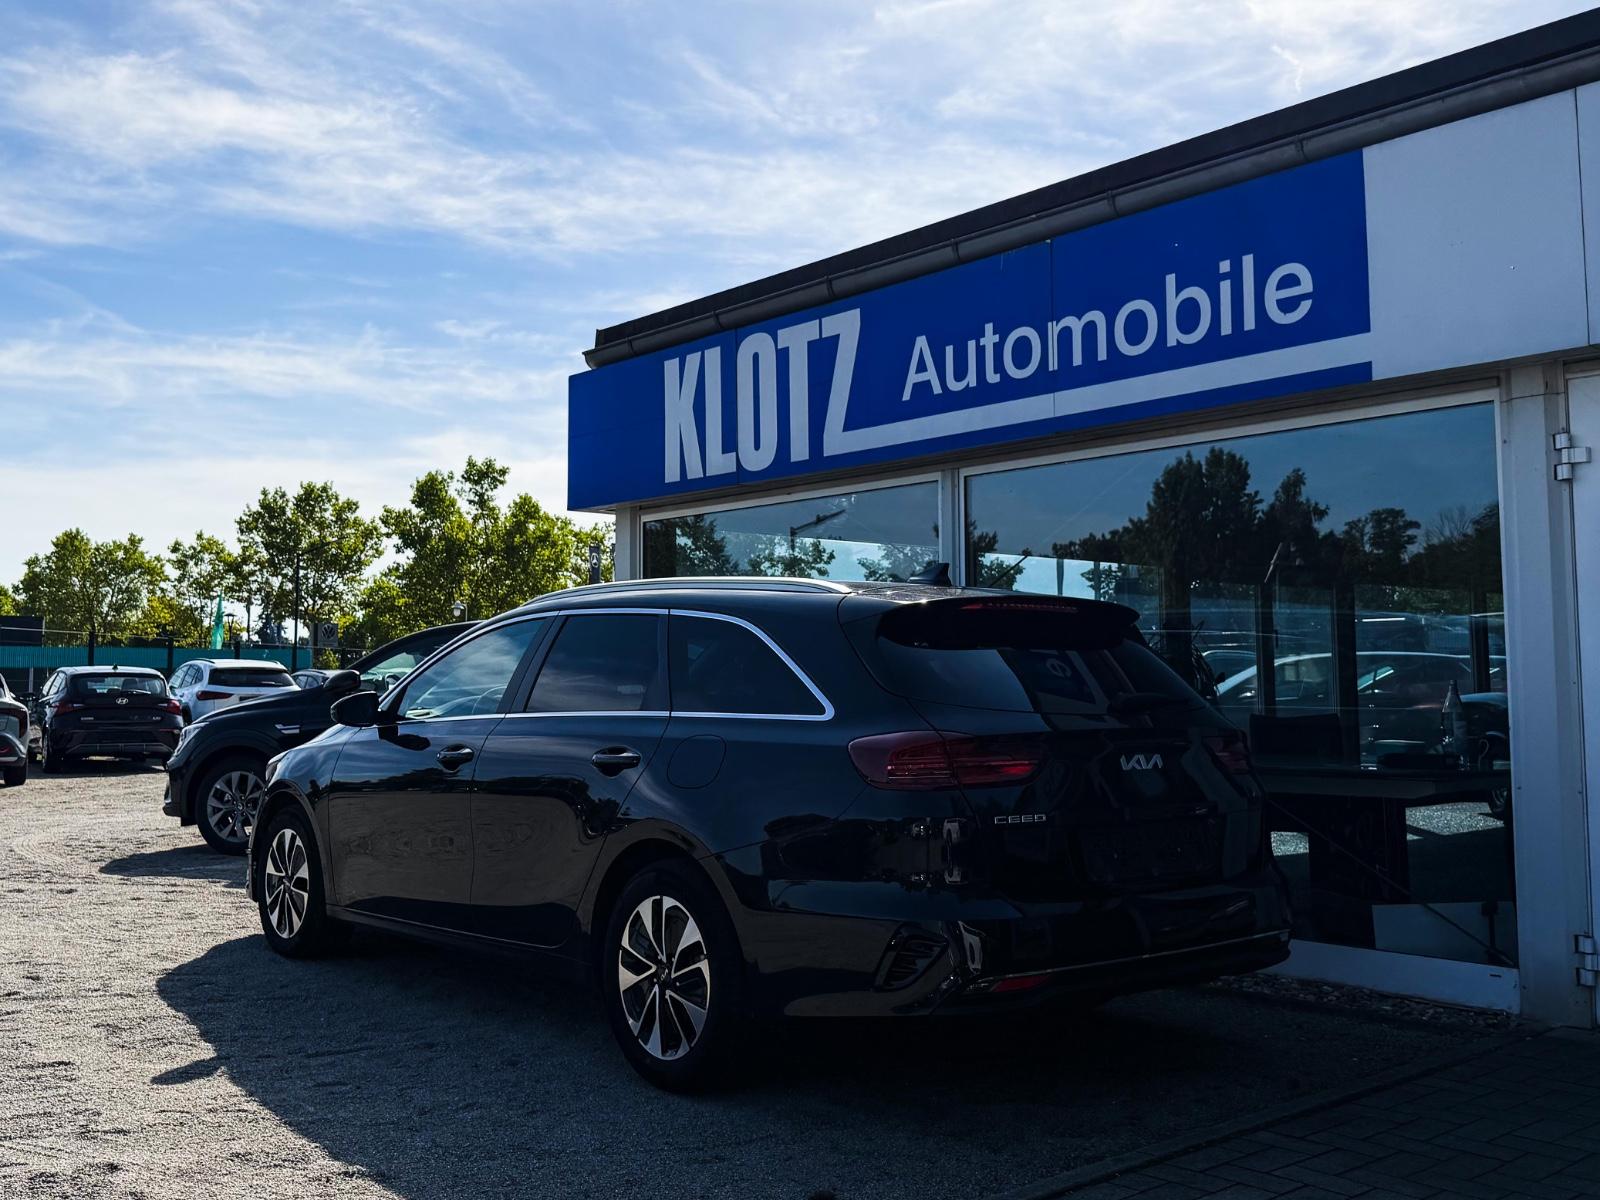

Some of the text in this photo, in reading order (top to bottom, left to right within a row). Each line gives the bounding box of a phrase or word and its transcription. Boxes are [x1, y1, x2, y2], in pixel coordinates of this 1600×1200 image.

[664, 253, 1313, 483] KLOTZ Automobile
[1120, 754, 1163, 771] KIA
[994, 814, 1047, 825] CEED
